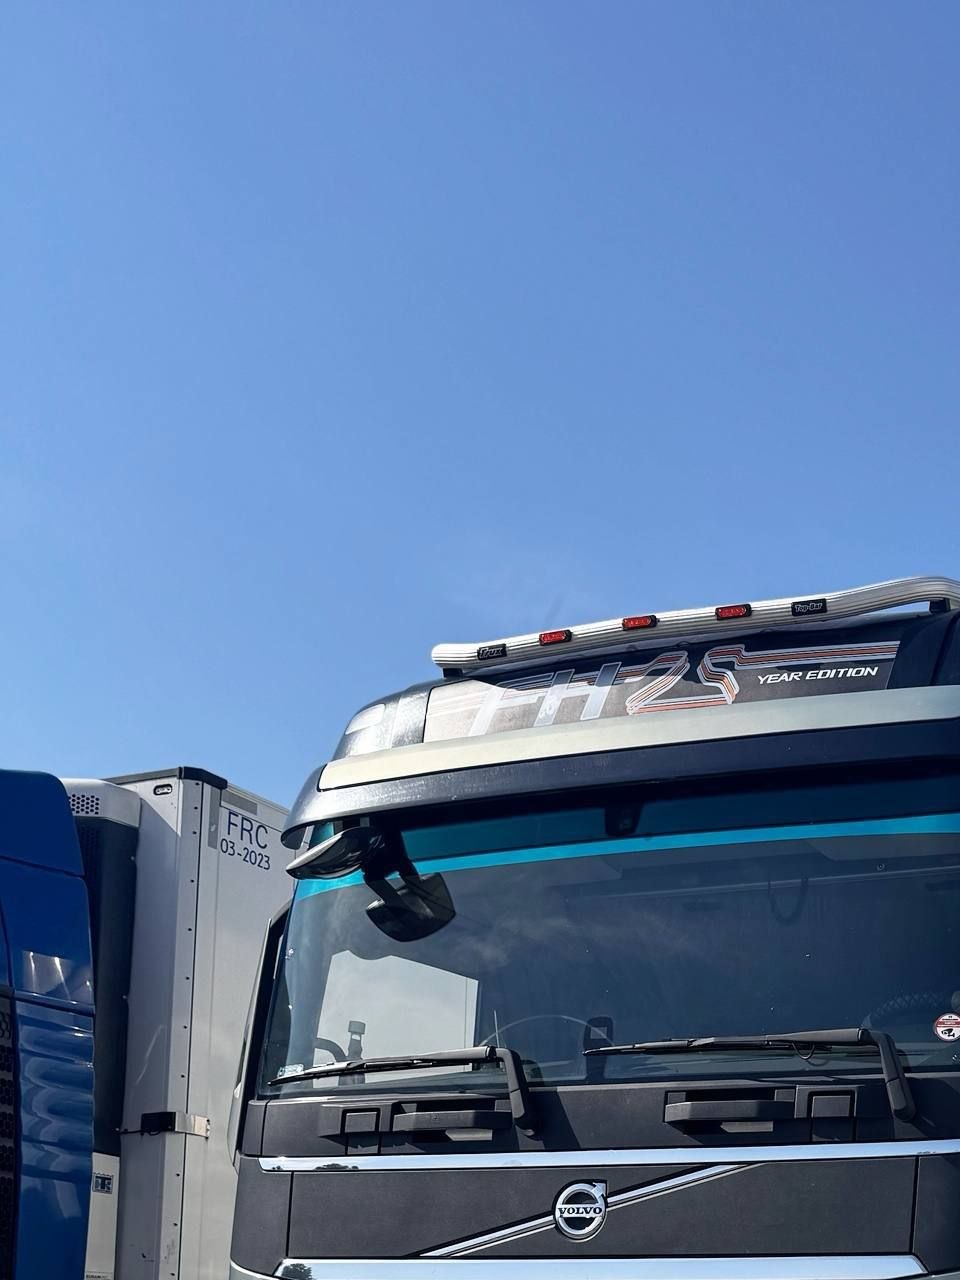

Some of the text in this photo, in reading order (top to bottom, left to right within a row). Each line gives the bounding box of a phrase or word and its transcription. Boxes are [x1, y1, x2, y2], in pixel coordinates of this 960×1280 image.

[479, 647, 503, 659] Trux
[758, 666, 878, 684] YEAR EDITION
[227, 810, 268, 849] FRC
[220, 838, 270, 870] 03-2023
[557, 1206, 603, 1215] VOLVO
